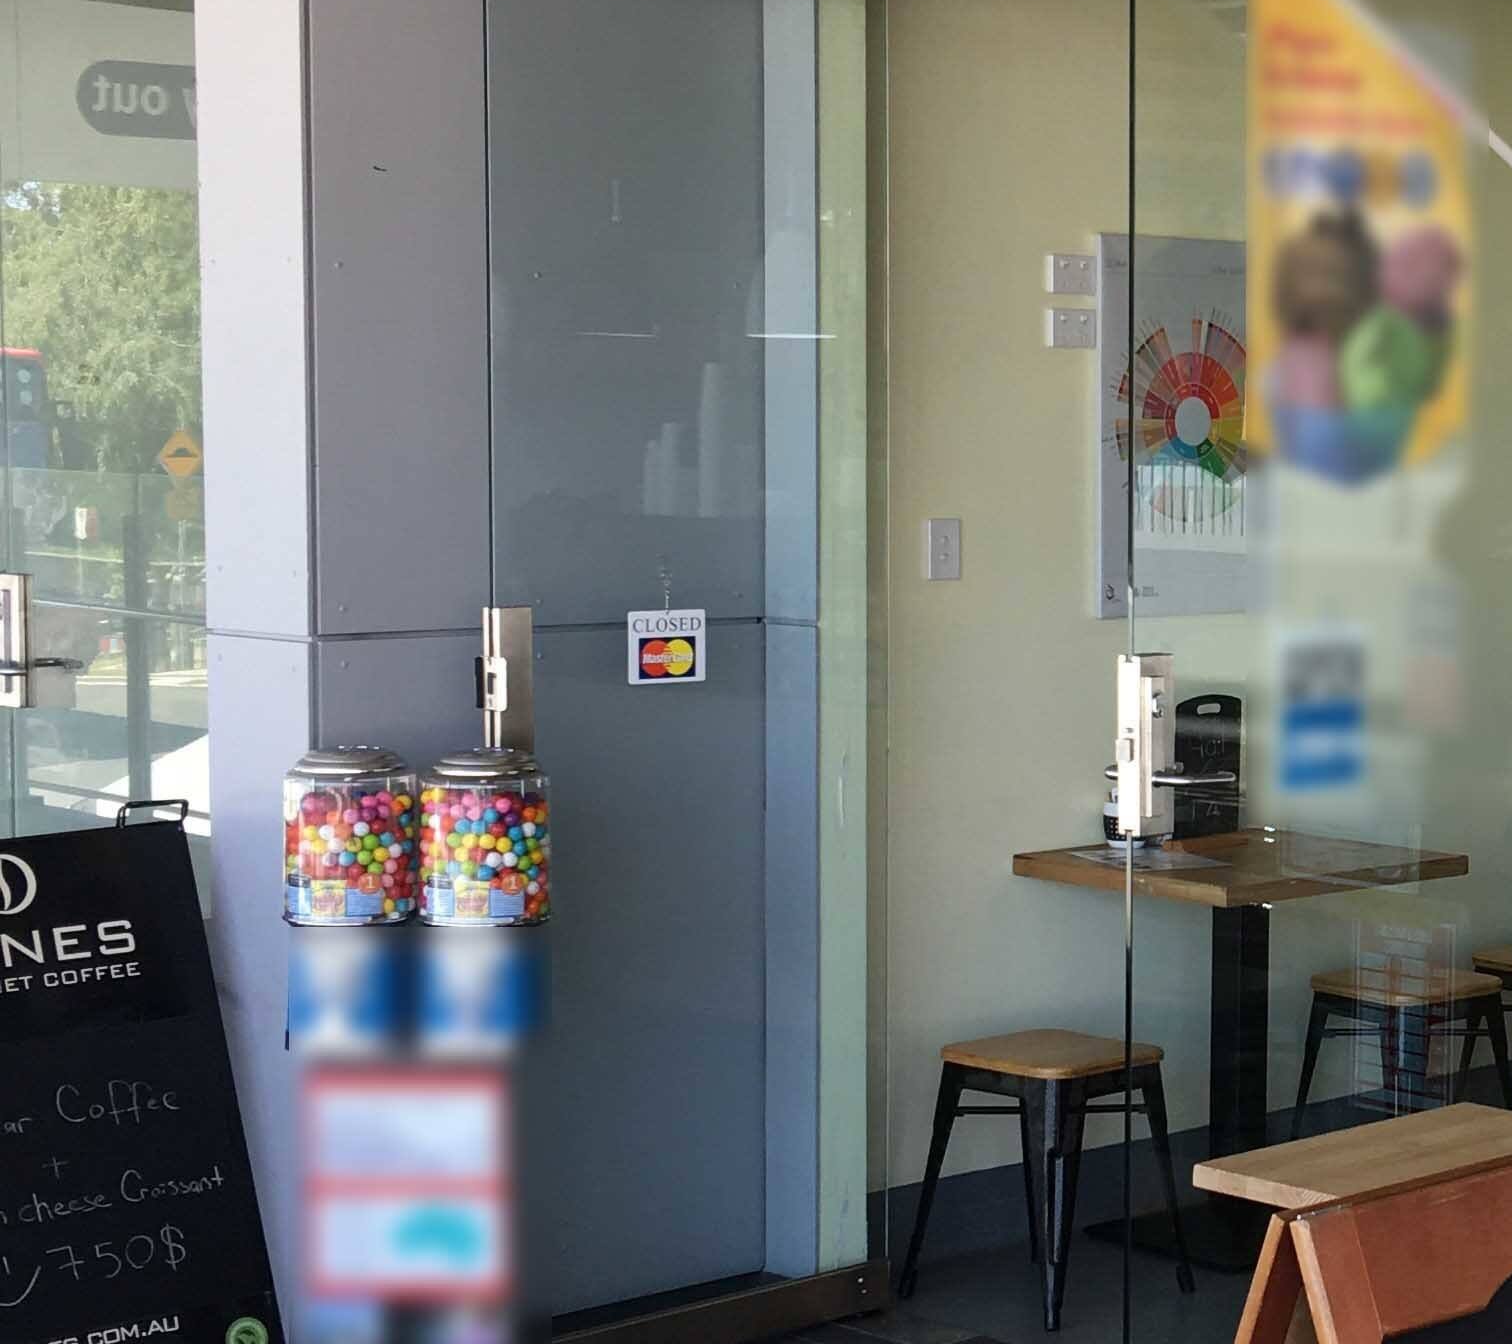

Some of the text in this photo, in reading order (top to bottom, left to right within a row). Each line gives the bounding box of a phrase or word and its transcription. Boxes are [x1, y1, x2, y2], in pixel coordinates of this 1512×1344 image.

[633, 617, 702, 633] CLOSED
[0, 920, 136, 968] NES
[0, 962, 141, 994] ET COFFEE
